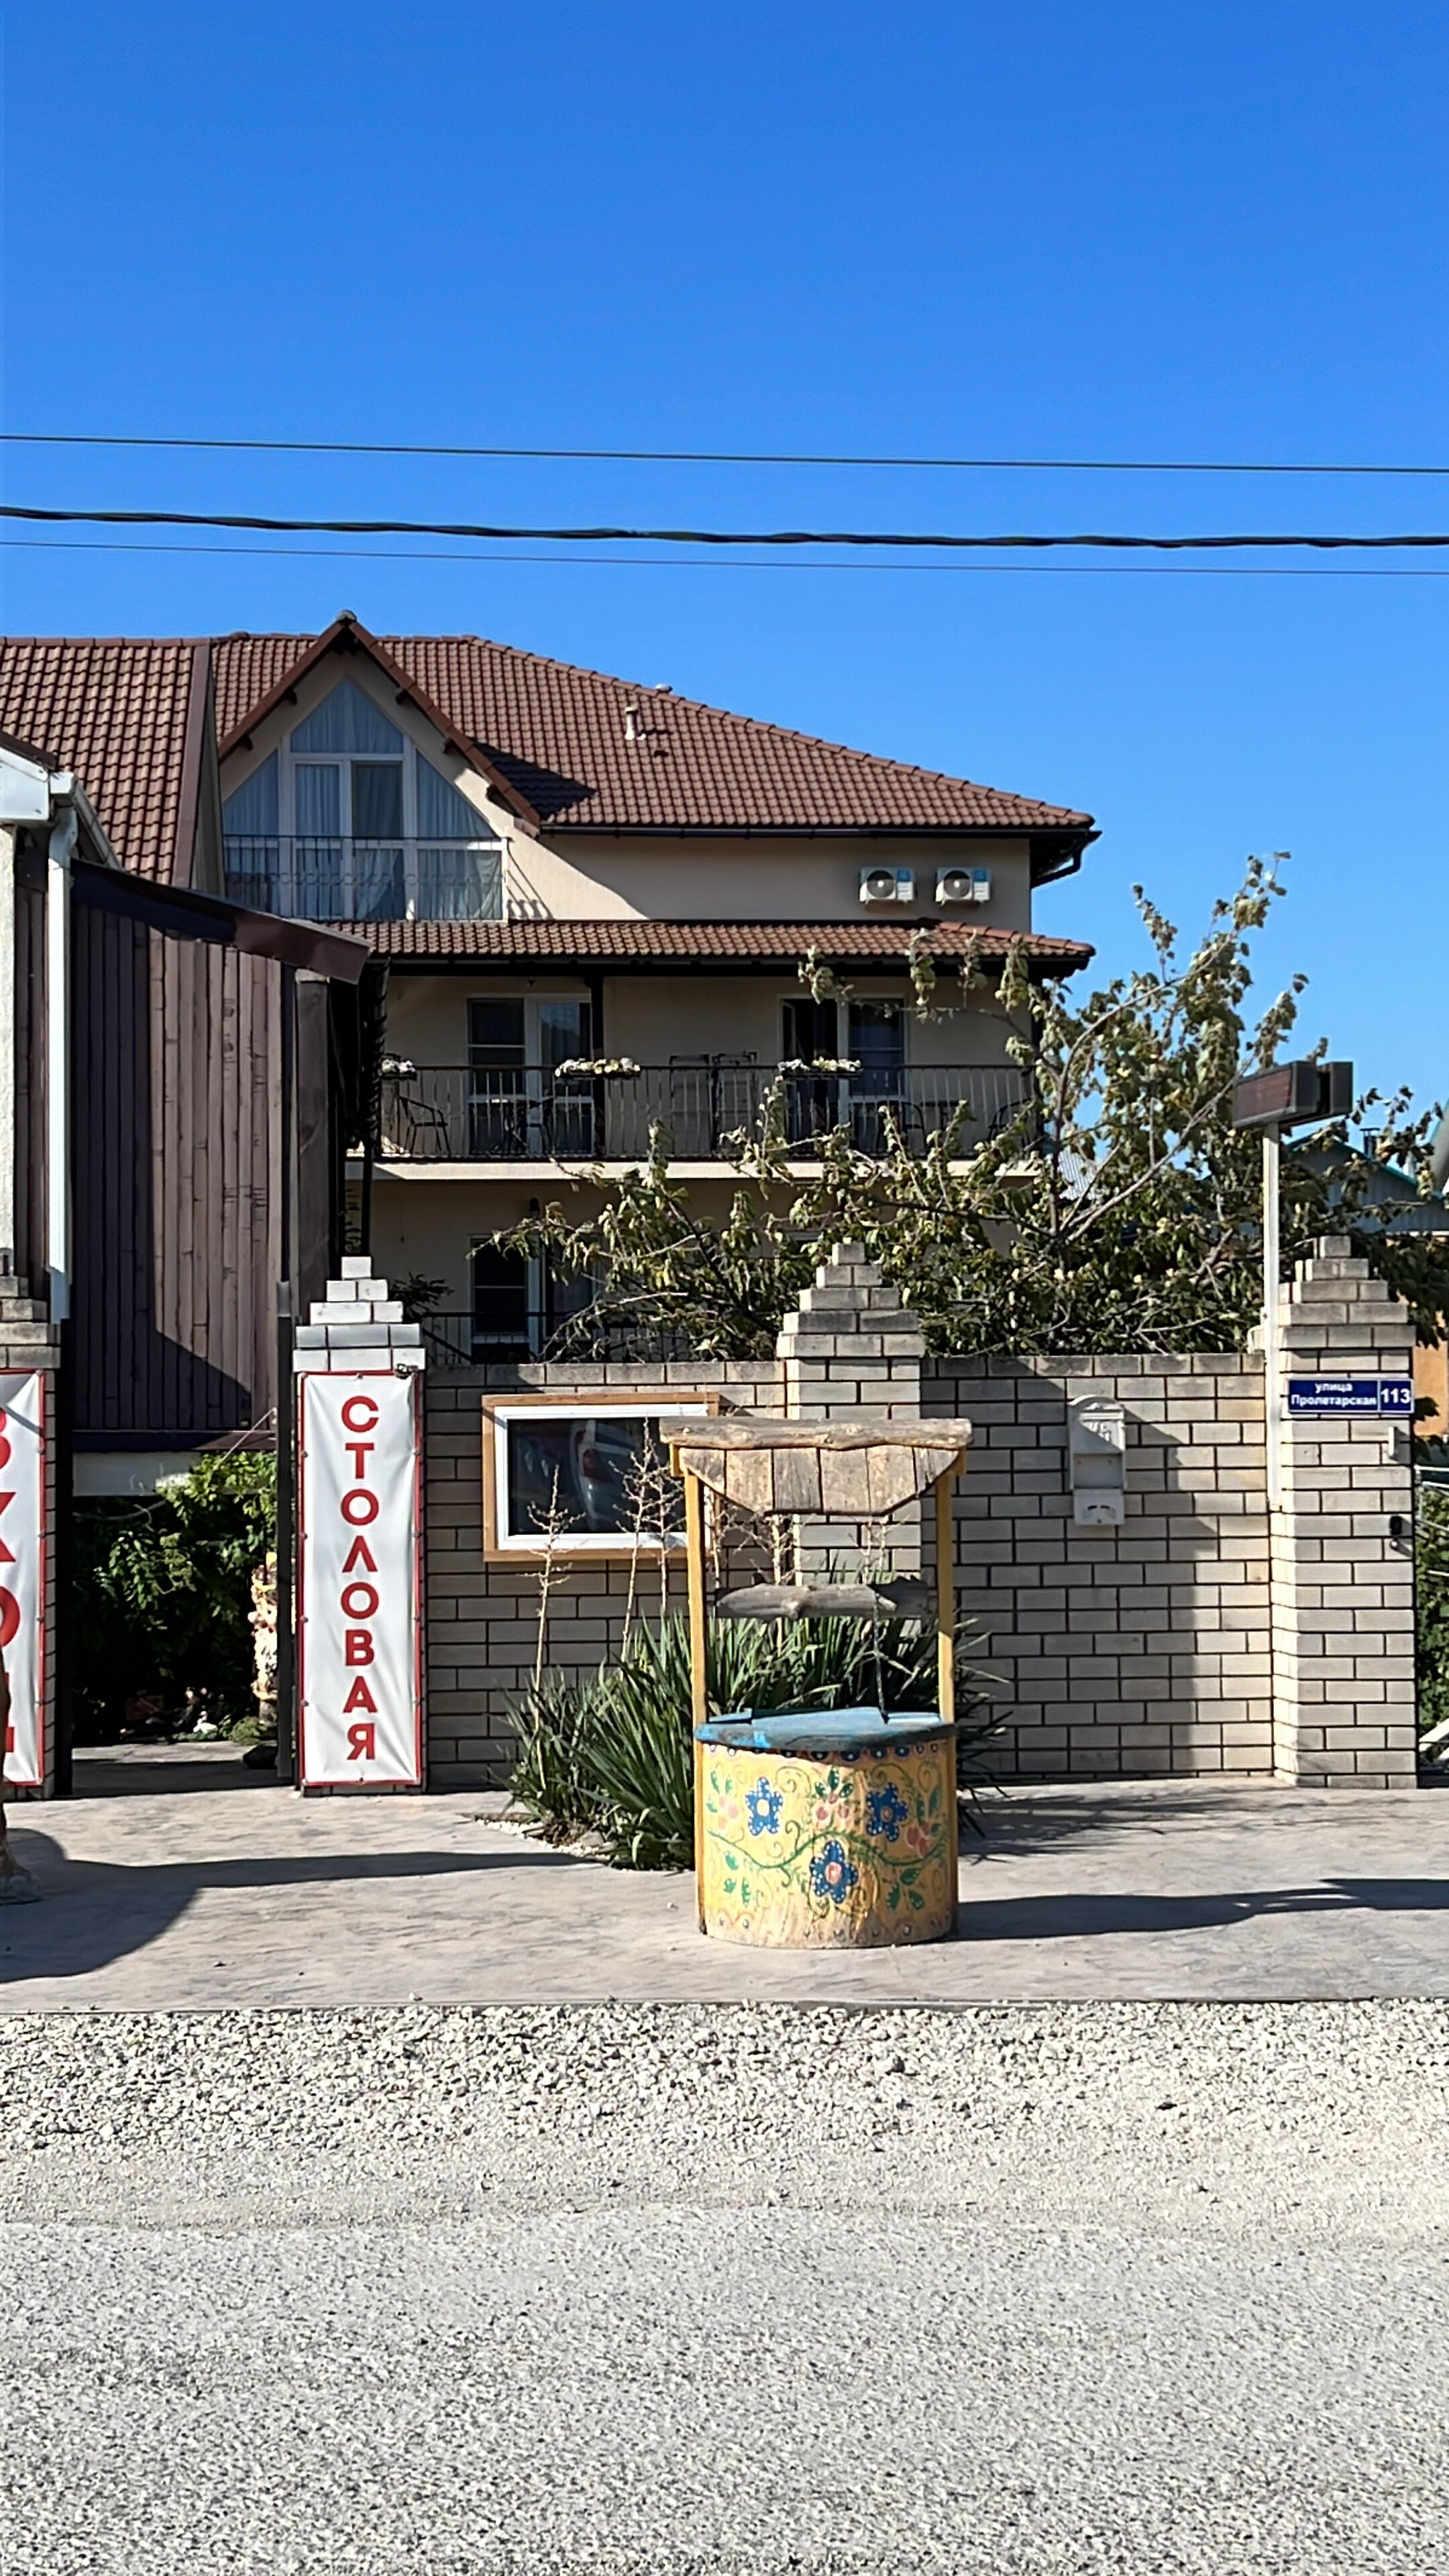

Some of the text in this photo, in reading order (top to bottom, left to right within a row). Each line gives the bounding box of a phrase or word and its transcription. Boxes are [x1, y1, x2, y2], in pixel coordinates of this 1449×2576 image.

[1315, 1383, 1353, 1393] улица
[1291, 1394, 1377, 1407] Пролетарская
[1381, 1388, 1411, 1404] 113
[341, 1395, 380, 1760] СТОЛОВАЯ
